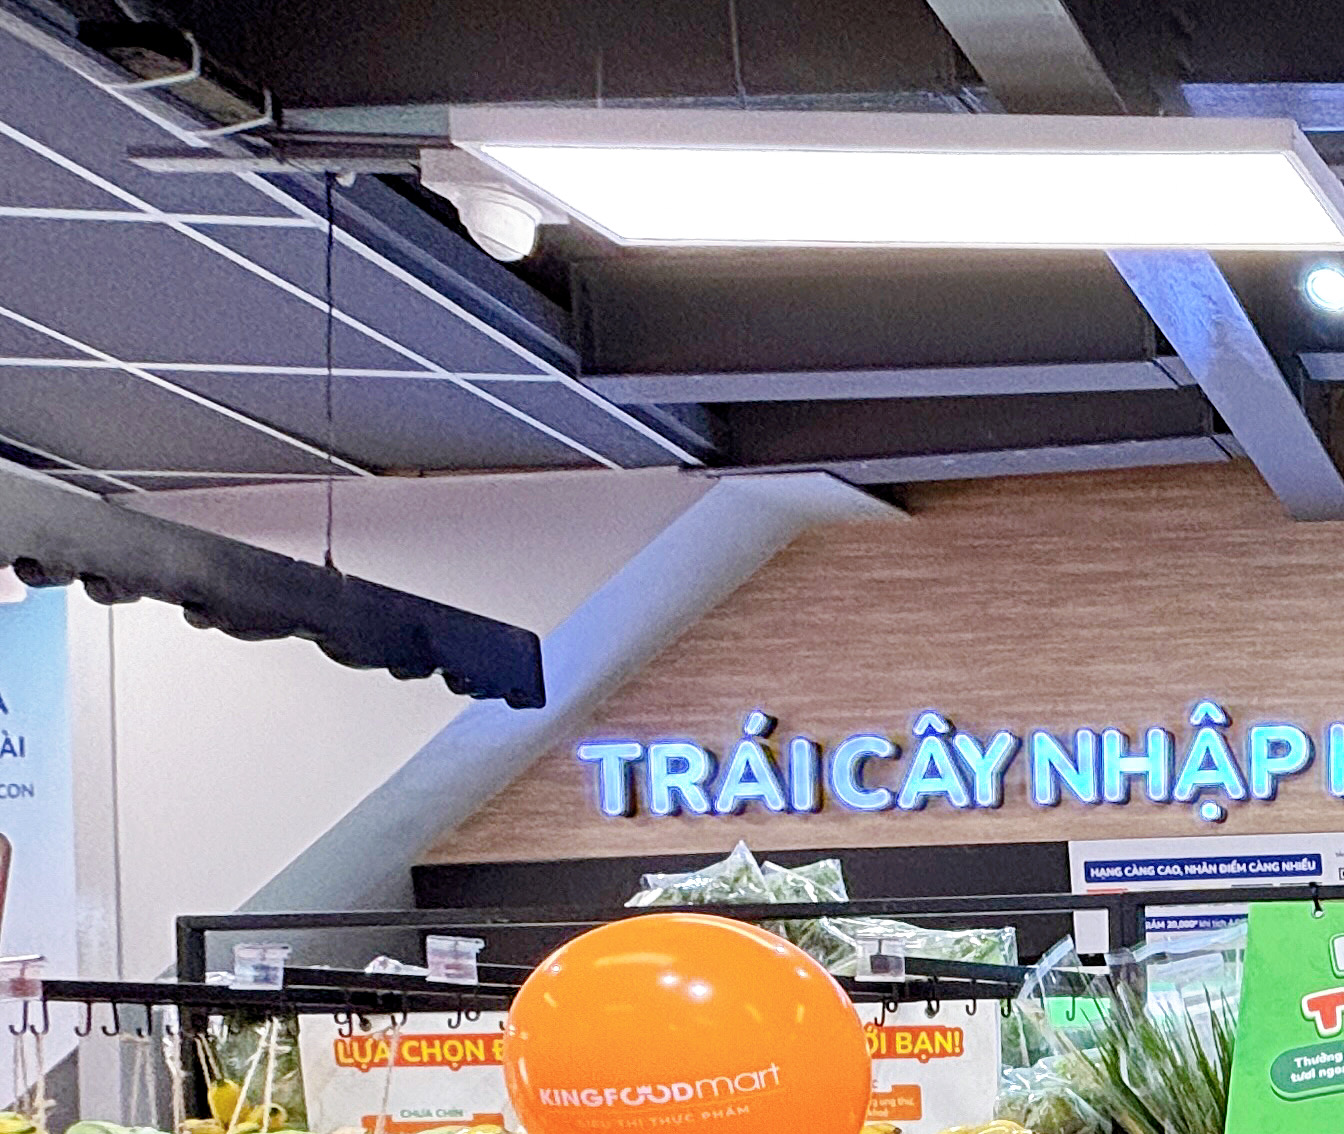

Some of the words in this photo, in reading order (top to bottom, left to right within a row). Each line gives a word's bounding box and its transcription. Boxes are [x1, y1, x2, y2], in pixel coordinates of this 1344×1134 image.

[578, 709, 820, 816] TRÁI
[828, 708, 1016, 811] CÂY
[1029, 700, 1314, 822] NHẬP
[1124, 863, 1155, 876] CÀNG
[1249, 858, 1279, 872] CÀNG
[336, 1037, 393, 1070] LỰA
[402, 1039, 485, 1068] CHỌN
[896, 1030, 961, 1060] BẠN!
[1294, 1052, 1344, 1068] Thường
[538, 1062, 781, 1108] KINGFOODmart
[1291, 1069, 1315, 1083] tươi
